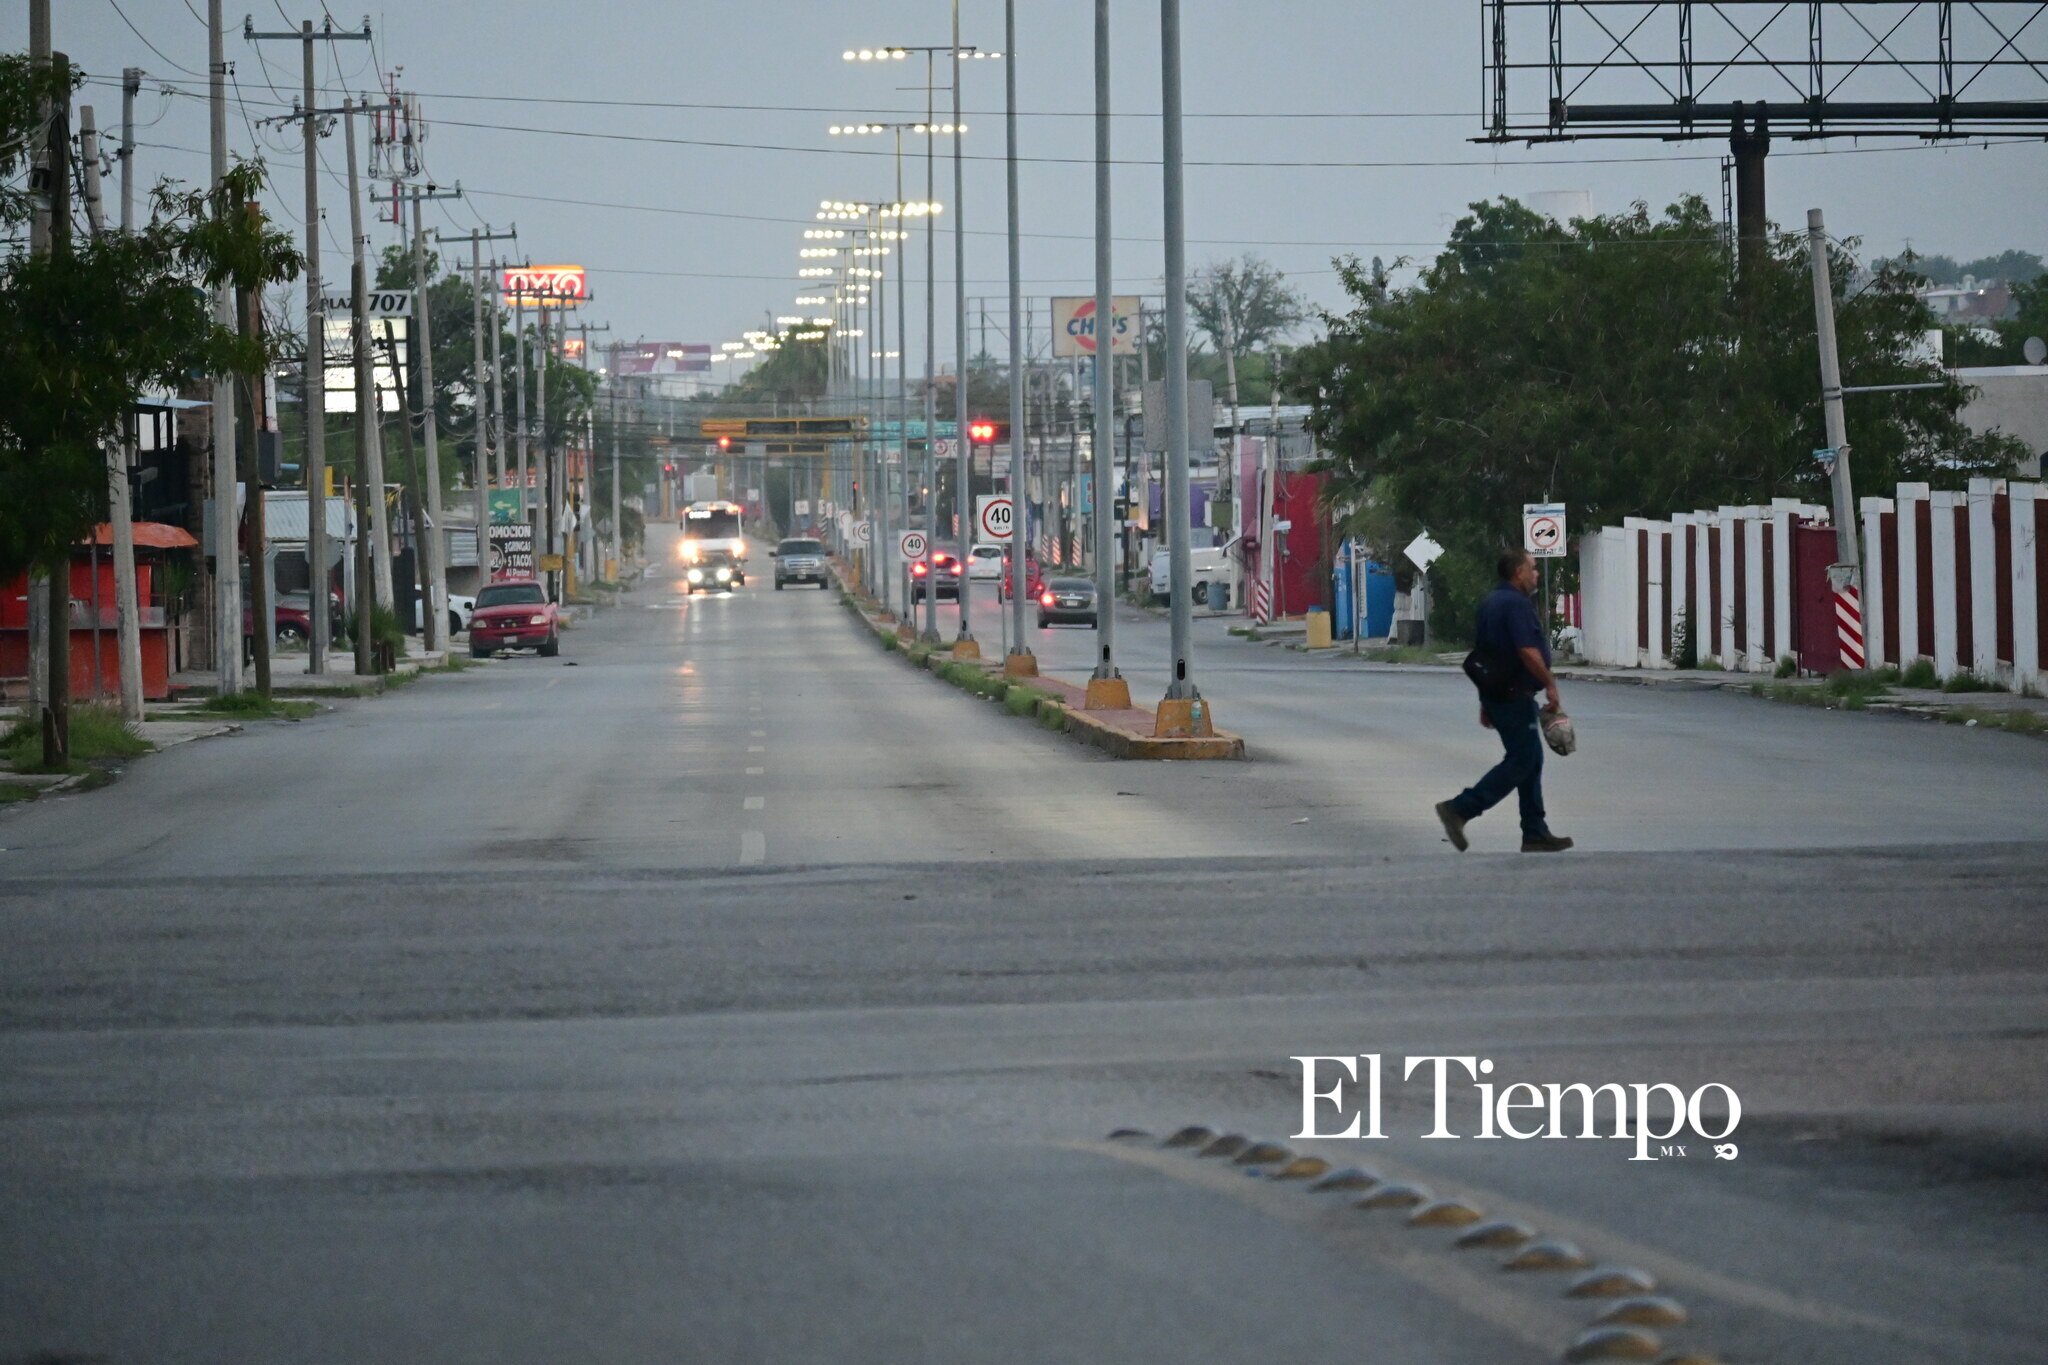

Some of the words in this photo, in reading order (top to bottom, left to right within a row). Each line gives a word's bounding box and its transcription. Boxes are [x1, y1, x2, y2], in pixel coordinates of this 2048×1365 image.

[320, 298, 353, 310] PLAZ
[368, 294, 408, 312] 707
[1067, 317, 1128, 335] CHS
[991, 507, 1010, 523] 40
[907, 538, 921, 549] 40
